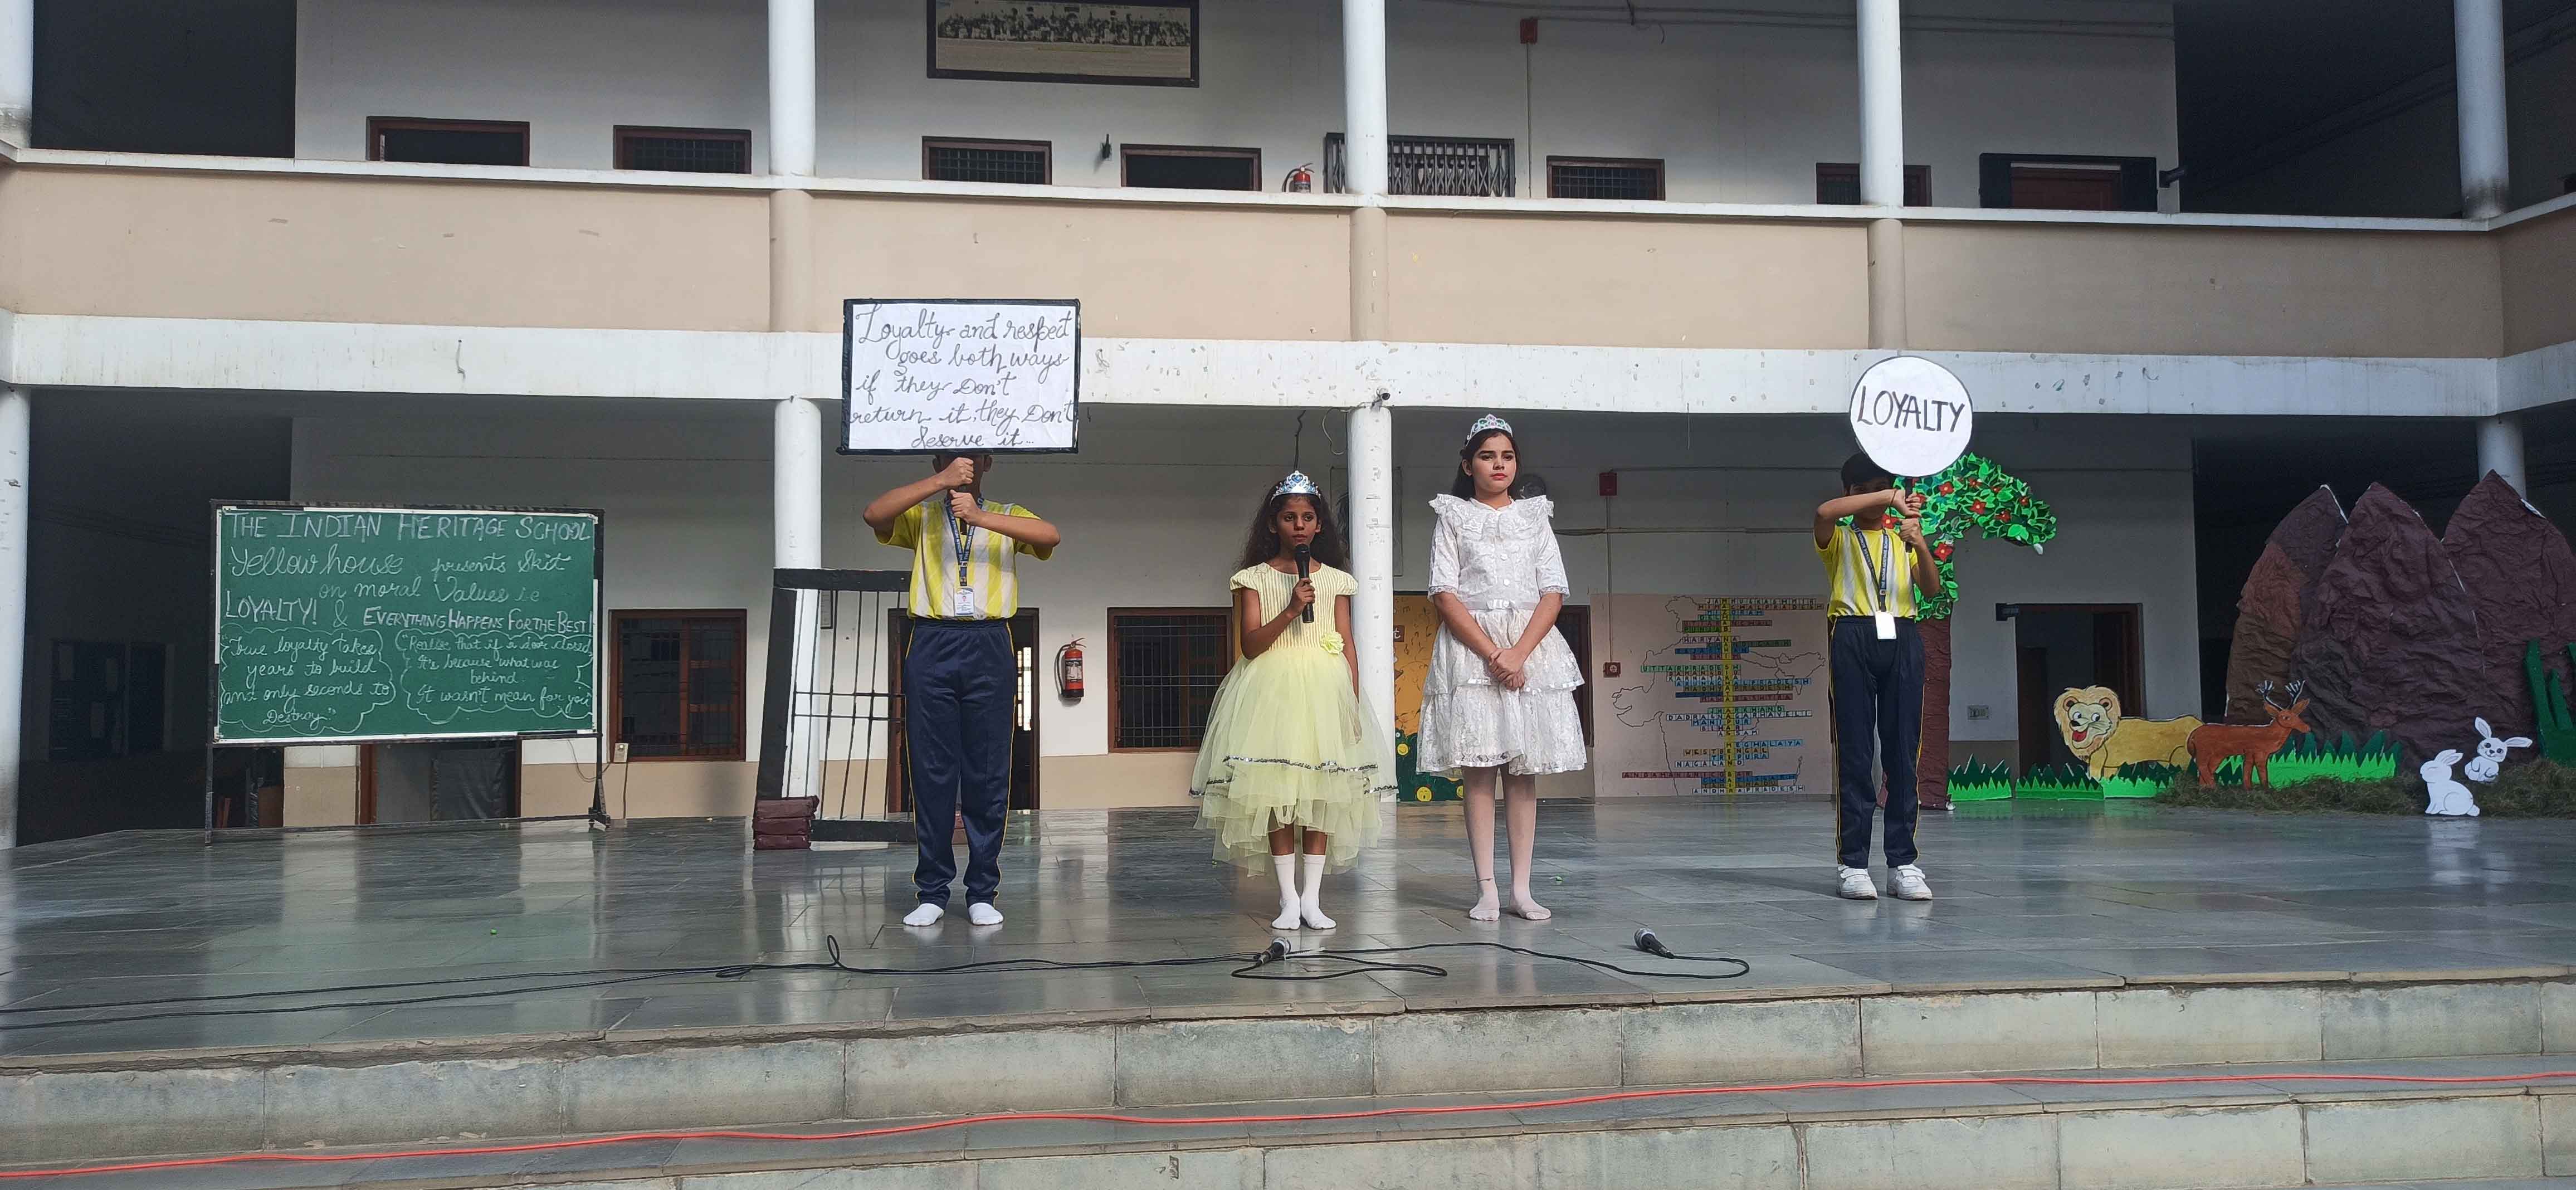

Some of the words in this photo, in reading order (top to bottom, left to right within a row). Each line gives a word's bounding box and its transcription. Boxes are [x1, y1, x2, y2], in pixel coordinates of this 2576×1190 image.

[855, 304, 954, 359] Loyalty
[959, 313, 1000, 339] and
[1003, 310, 1072, 353] respect
[894, 351, 942, 376] goes
[948, 344, 1007, 373] both
[1010, 352, 1070, 384] ways
[856, 369, 881, 405] if
[894, 376, 953, 401] they
[953, 371, 1016, 396] Don't
[850, 407, 931, 424] return
[975, 399, 1020, 437] they
[1857, 386, 1965, 433] LOYALTY
[223, 513, 267, 538] THE
[276, 513, 382, 543] INDIAN
[397, 514, 508, 542] HERITAGE
[516, 516, 591, 544] SCHOOL
[432, 552, 506, 582] presents
[319, 584, 347, 598] on
[354, 576, 422, 598] moral
[434, 576, 509, 602] Values
[226, 591, 317, 626] LOYALTY!
[333, 599, 348, 627] &
[363, 606, 446, 628] EVERYTHING
[448, 608, 504, 629] HAPPENS
[274, 636, 329, 662] loyalty
[332, 633, 377, 656] takes
[443, 653, 493, 669] because
[499, 657, 530, 669] what
[531, 659, 561, 669] was
[455, 637, 482, 650] that
[484, 638, 502, 661] if
[519, 637, 549, 650] door
[246, 664, 294, 689] years
[305, 661, 322, 676] to
[329, 657, 377, 676] build
[224, 685, 257, 705] and
[263, 685, 301, 714] only
[304, 681, 363, 696] seconds
[369, 683, 390, 696] to
[416, 684, 436, 705] It
[440, 686, 491, 703] wasn't
[494, 691, 535, 703] mean
[540, 686, 564, 711] for
